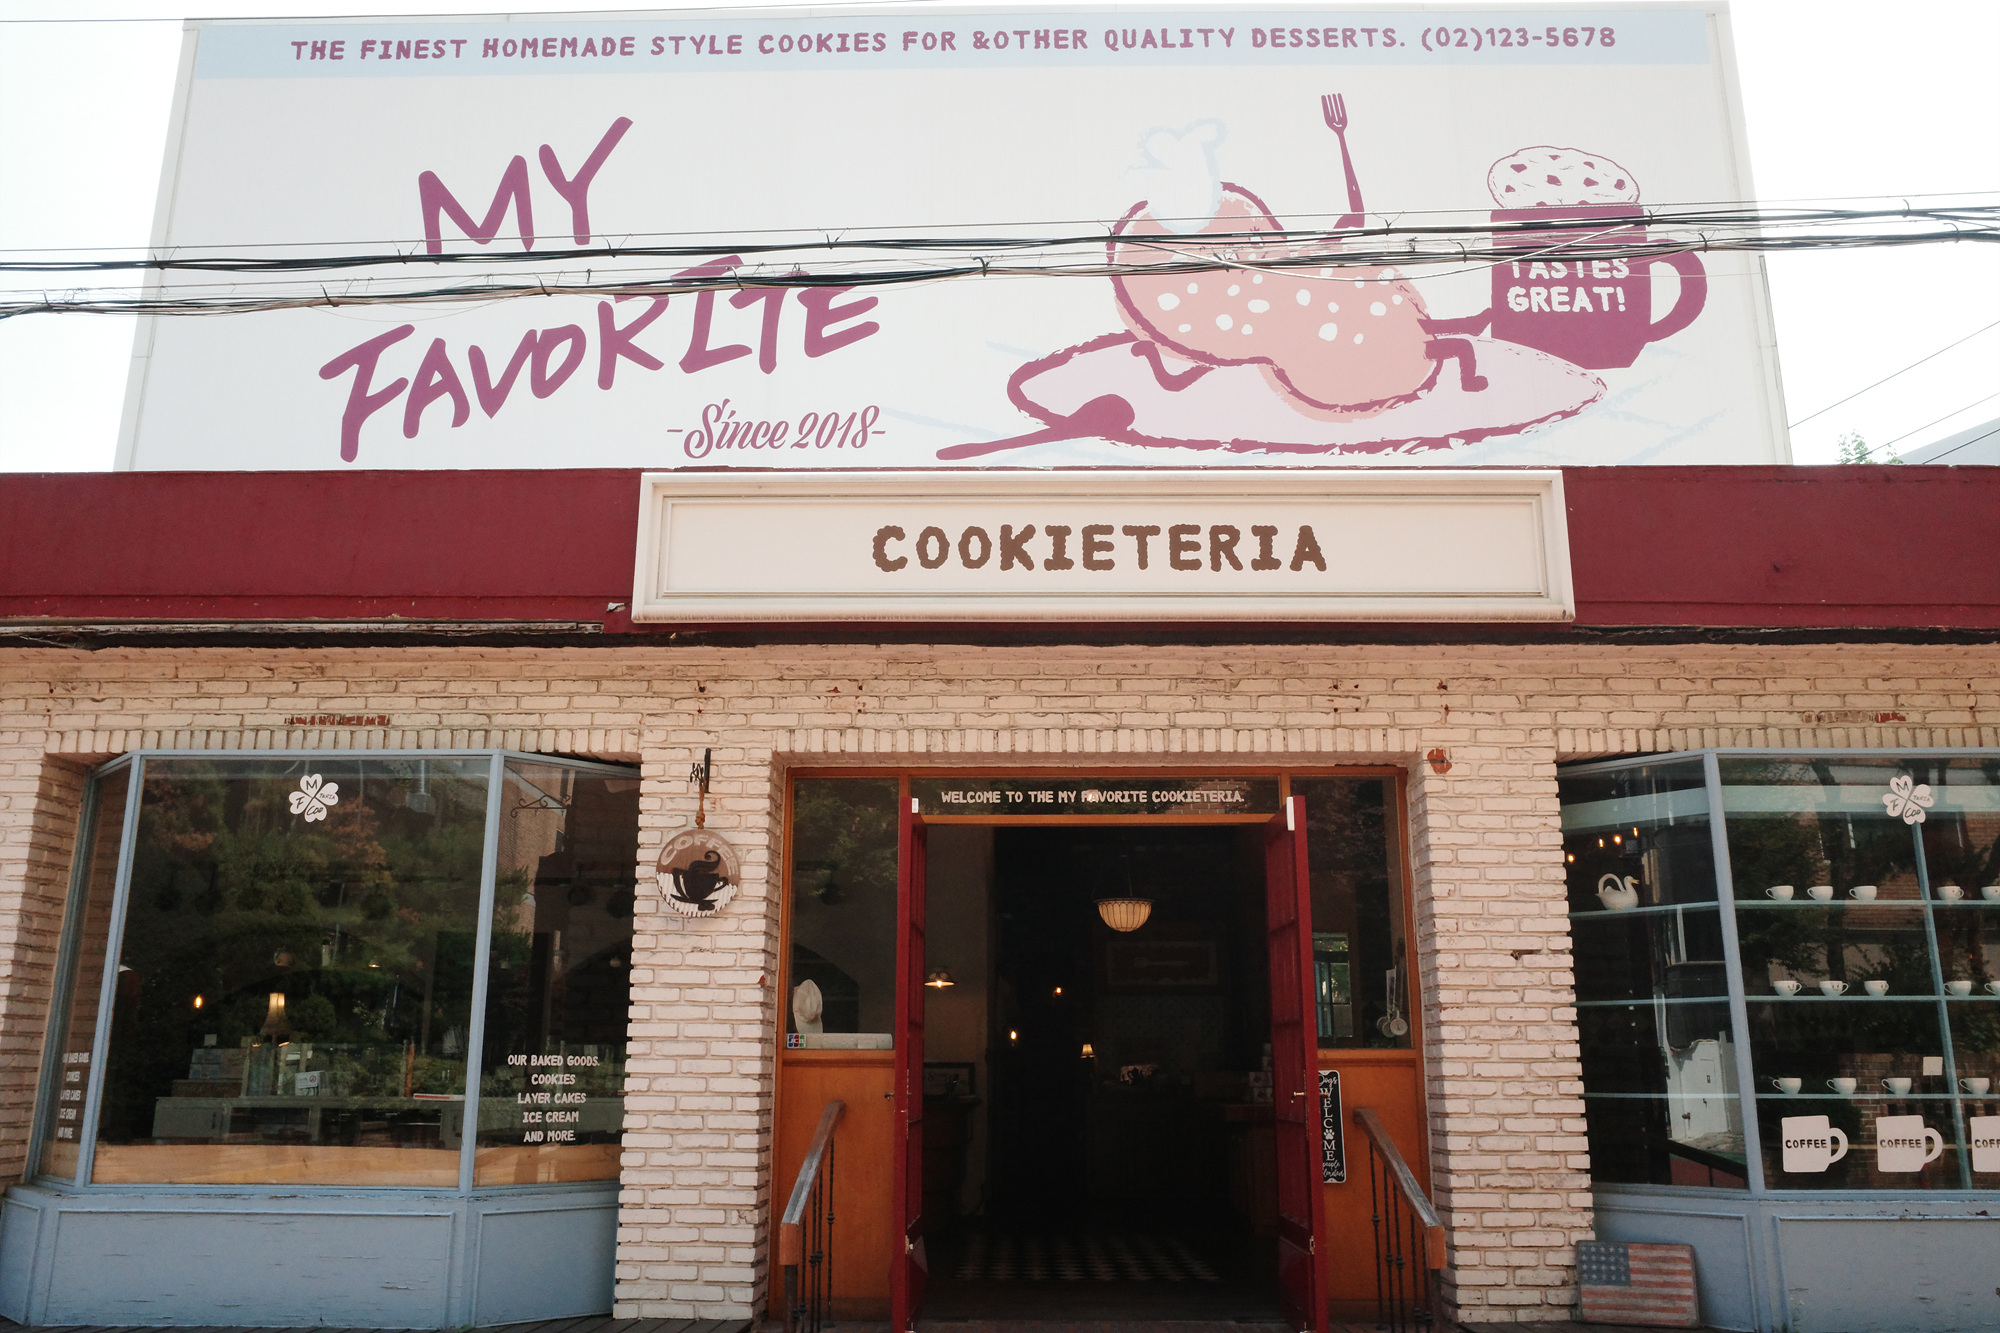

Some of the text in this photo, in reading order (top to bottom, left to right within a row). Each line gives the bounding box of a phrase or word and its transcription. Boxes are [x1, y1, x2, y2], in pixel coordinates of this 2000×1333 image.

[291, 26, 1616, 61] THE FINEST HOMEMADE STYLE COOKIES FOR &OTHER QUALITY DESSERTS. (02)123-5678
[419, 117, 633, 264] MY
[1507, 286, 1626, 313] GREAT!
[319, 255, 880, 463] FAVORITE
[872, 524, 1327, 572] COOKIETERIA
[306, 779, 318, 790] M
[1895, 781, 1909, 793] M
[296, 796, 305, 809] F
[941, 790, 1245, 803] WELCOME TO THE MY FAVORITE COOKIETERIA.
[1890, 798, 1899, 811] F
[660, 834, 739, 876] COFFEE
[507, 1054, 600, 1067] OUR BAKED GOODS.
[531, 1074, 576, 1085] COOKIES
[517, 1092, 587, 1104] LAYER CAKES
[522, 1111, 579, 1123] ICE CREAM
[523, 1130, 576, 1142] AND MORE.
[1785, 1139, 1827, 1149] COFFEE
[1880, 1138, 1922, 1149] COFFEE
